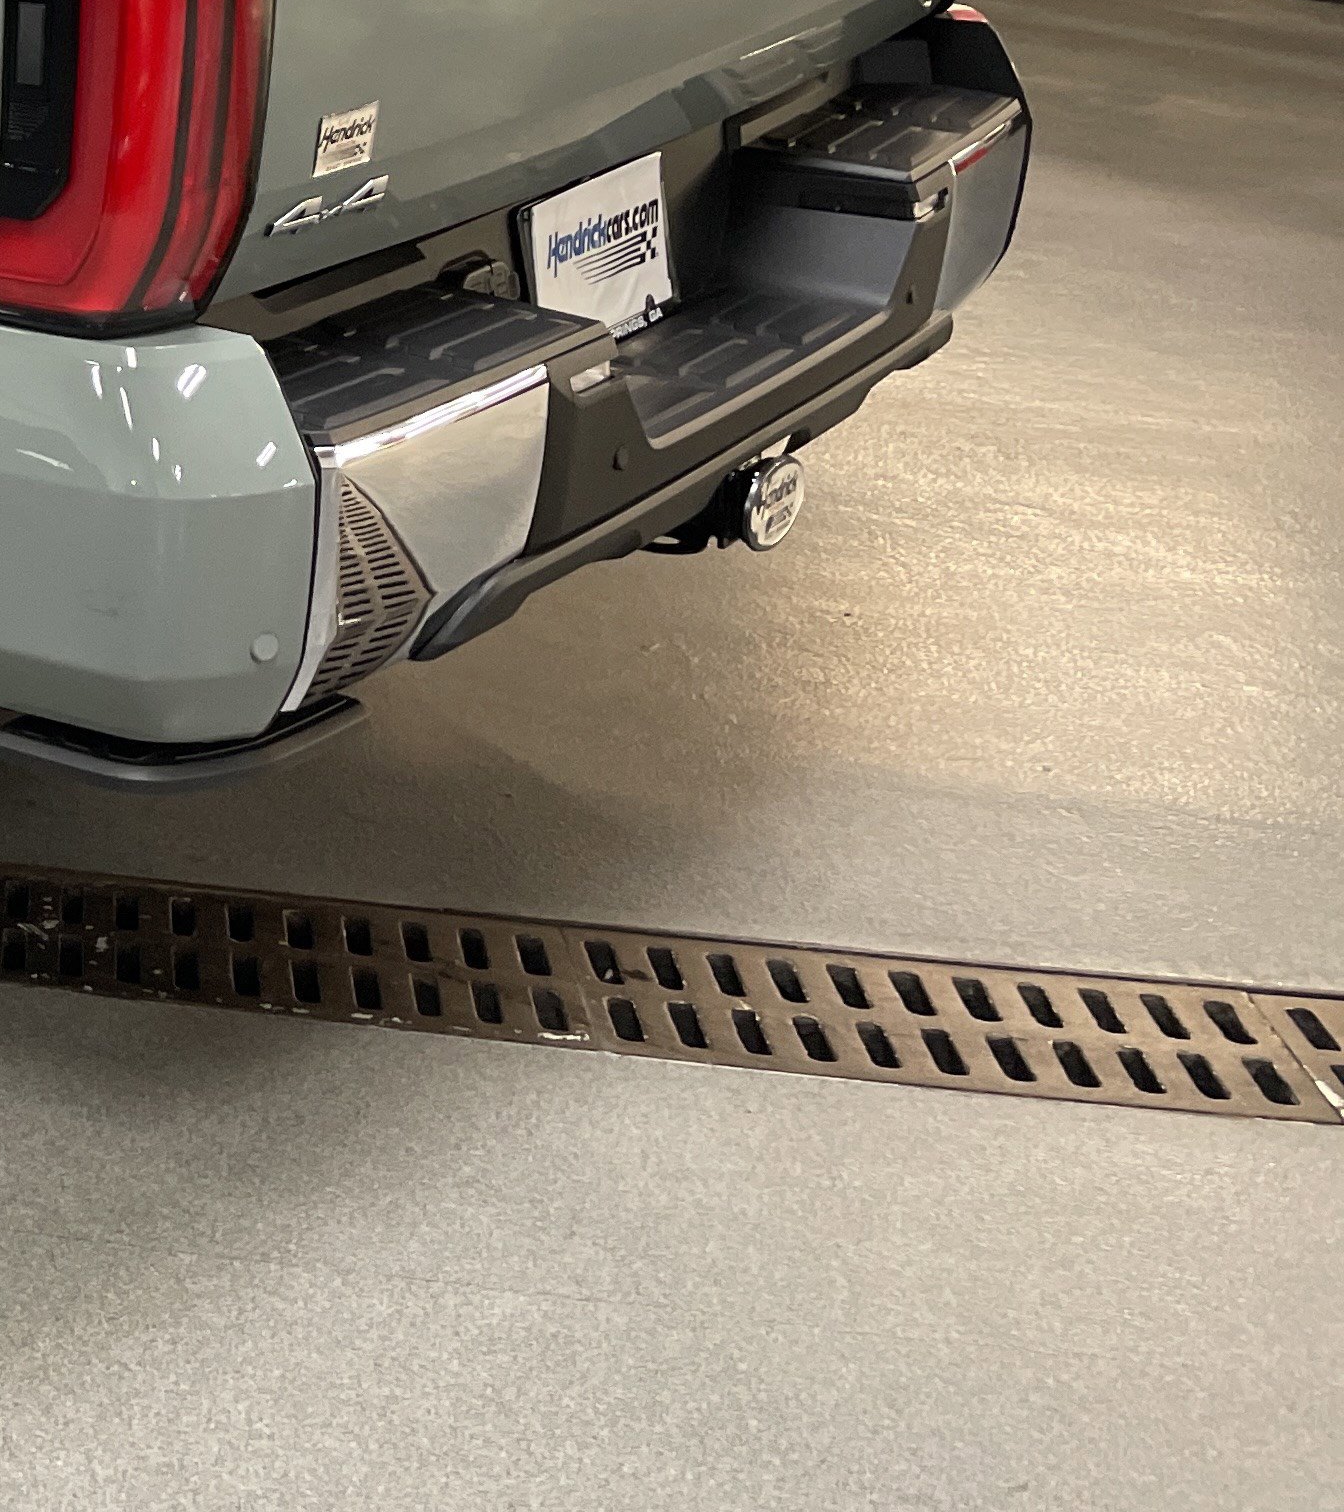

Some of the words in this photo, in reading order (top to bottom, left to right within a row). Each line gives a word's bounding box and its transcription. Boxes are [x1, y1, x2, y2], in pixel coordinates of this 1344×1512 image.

[318, 114, 375, 154] Hendrick
[268, 174, 389, 238] 4x4
[547, 198, 659, 279] Hendrickcars.com
